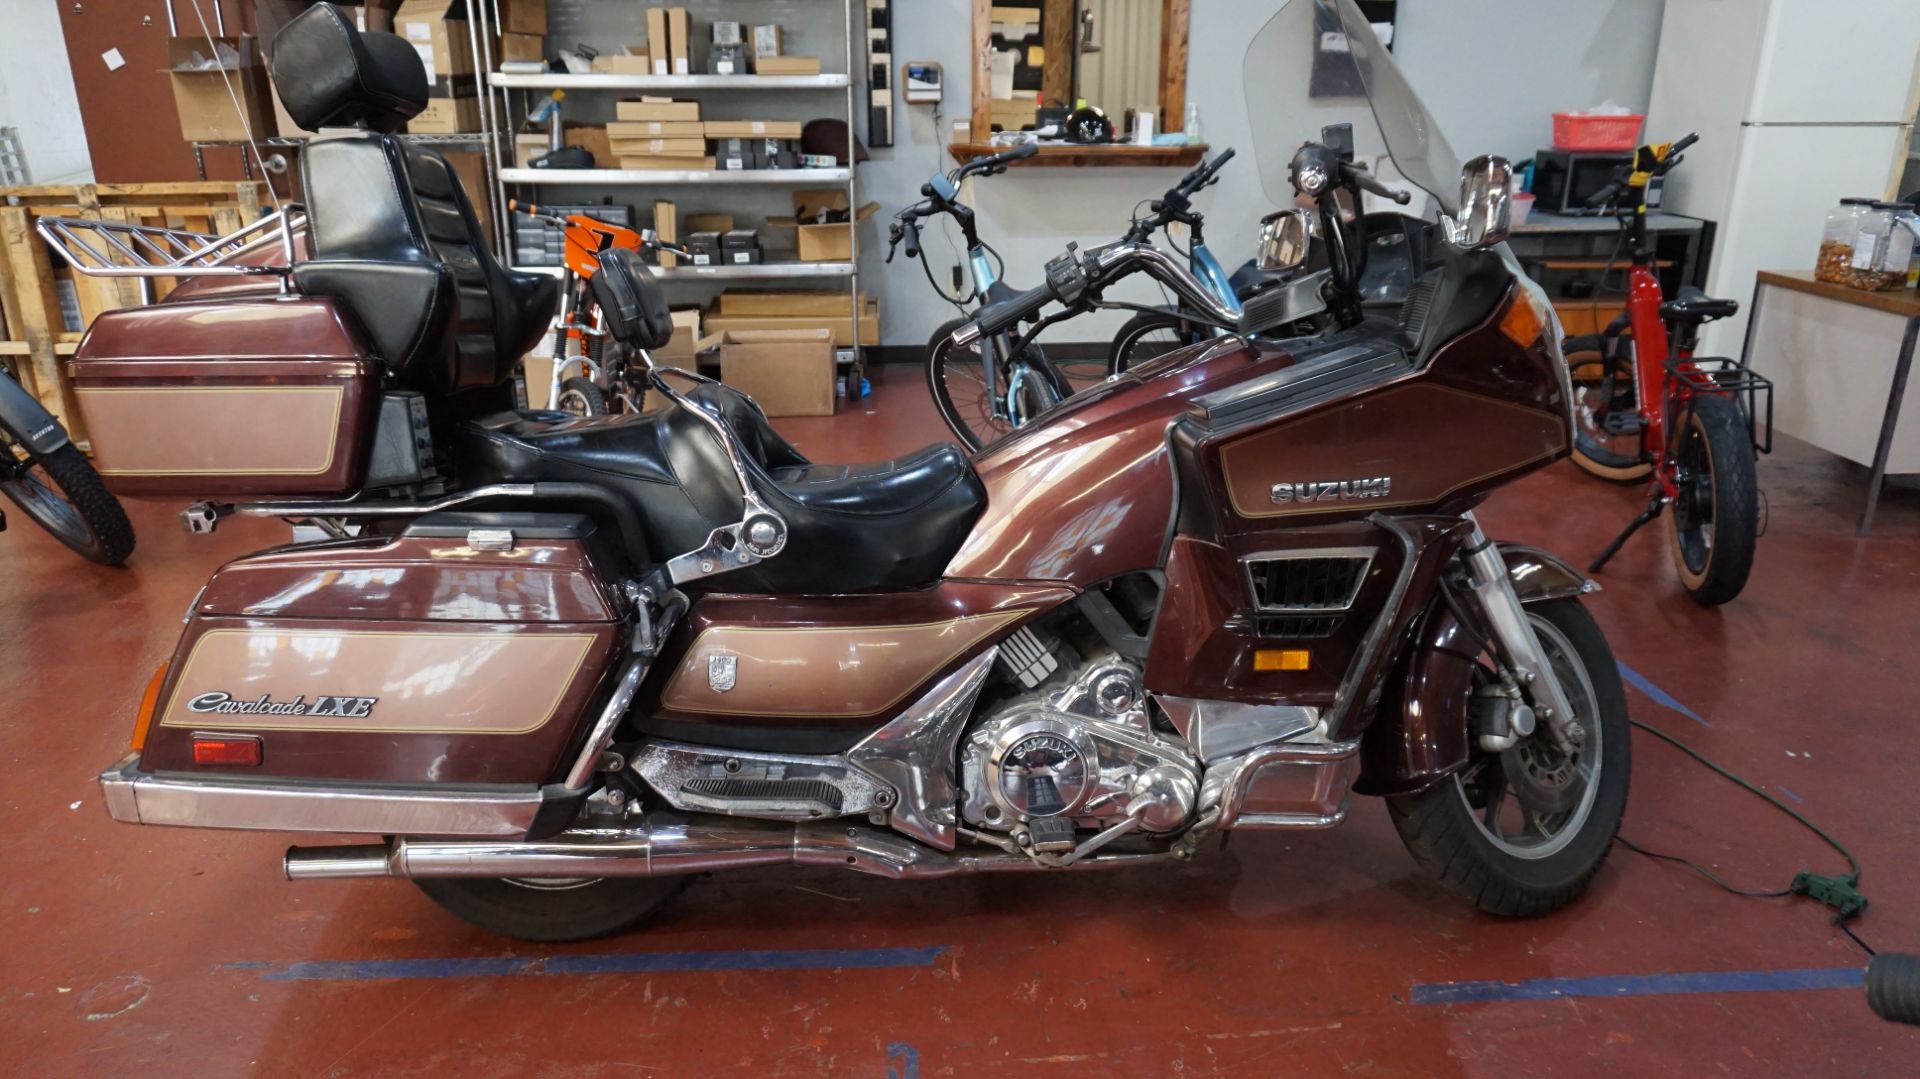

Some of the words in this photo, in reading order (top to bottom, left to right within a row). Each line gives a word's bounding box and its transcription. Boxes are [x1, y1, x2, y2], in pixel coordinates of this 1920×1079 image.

[1270, 477, 1391, 505] SUZUKI
[187, 691, 305, 716] Cavalcade
[305, 696, 379, 718] LXE
[1013, 737, 1077, 762] SUZUKI
